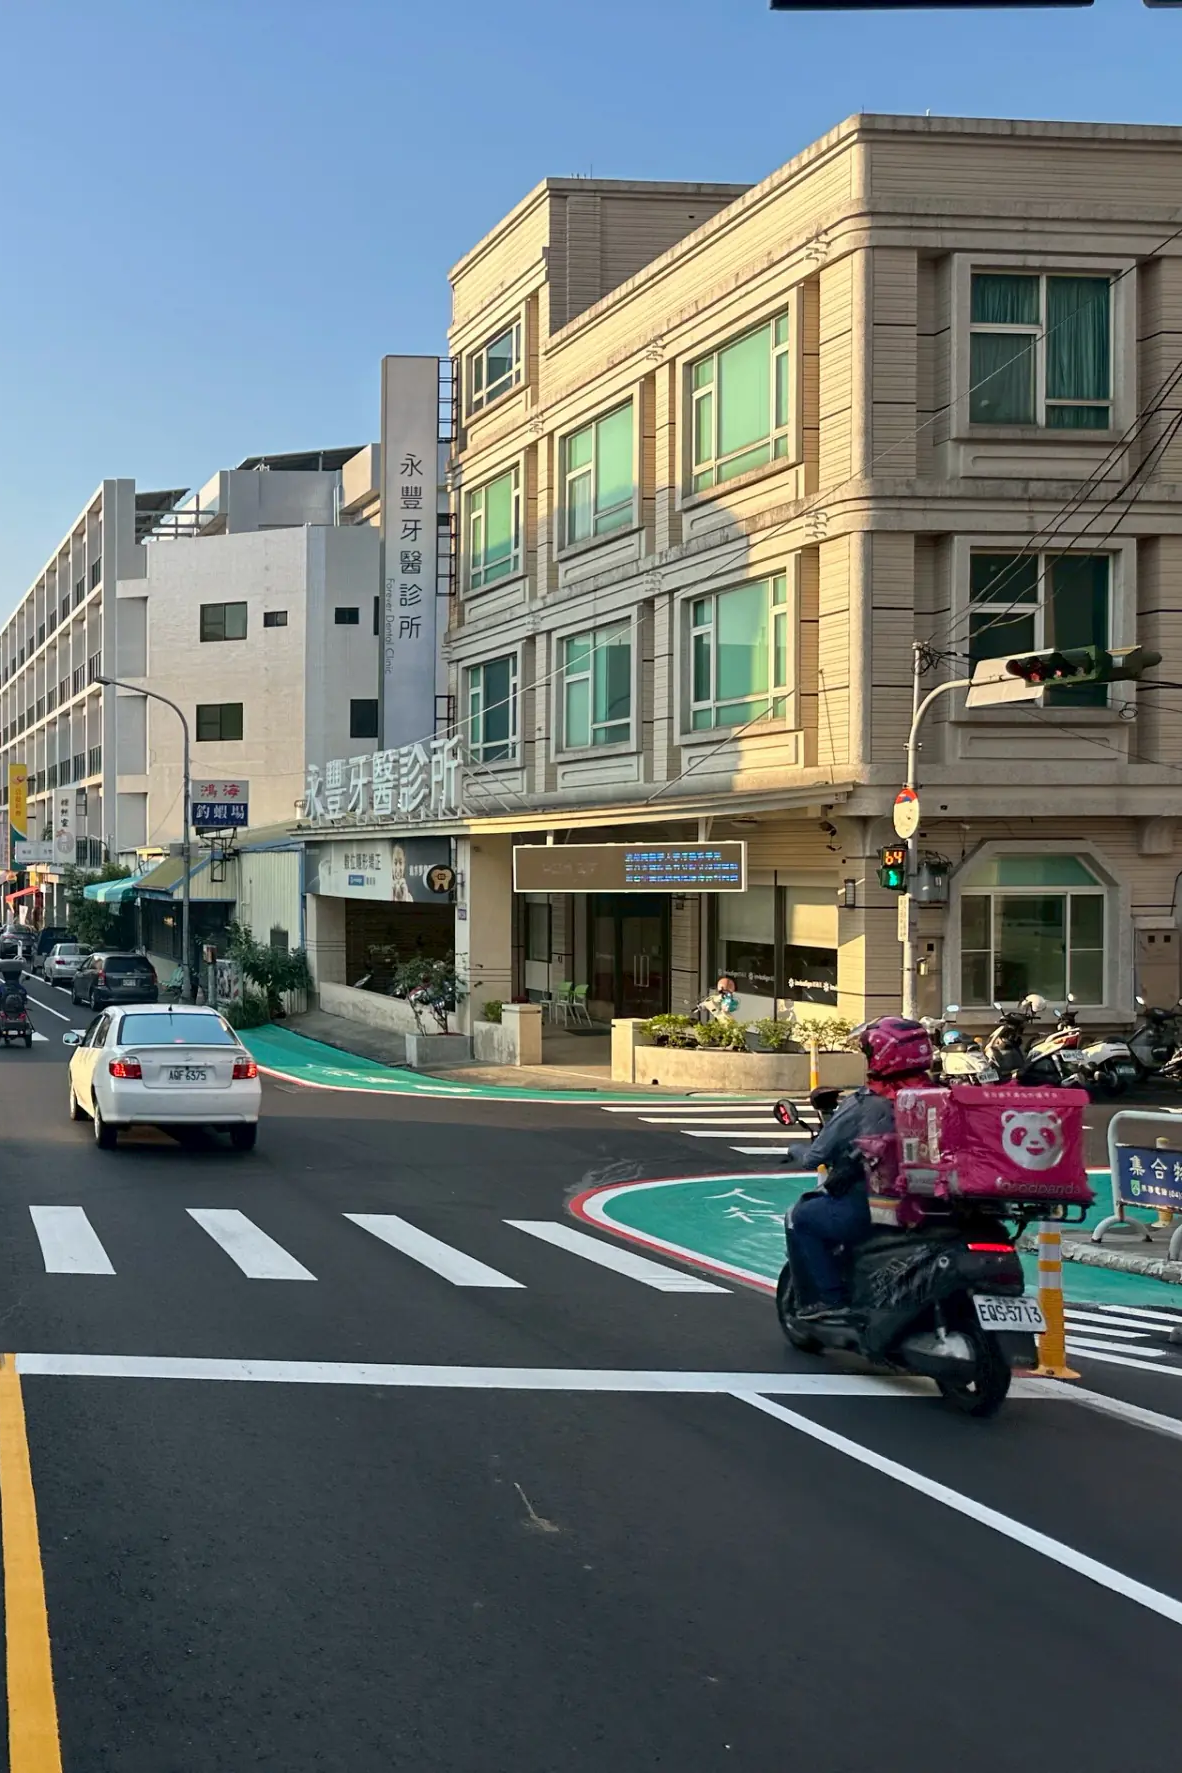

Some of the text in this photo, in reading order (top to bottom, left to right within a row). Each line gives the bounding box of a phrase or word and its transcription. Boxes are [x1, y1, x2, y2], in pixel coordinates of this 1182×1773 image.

[399, 453, 423, 639] 永豐牙醫診所
[385, 578, 395, 675] Forever Dental Clinic
[200, 783, 241, 798] 鴻海
[304, 734, 464, 821] 永豐牙醫診所
[195, 804, 246, 820] 釣蝦場
[885, 851, 903, 866] 64
